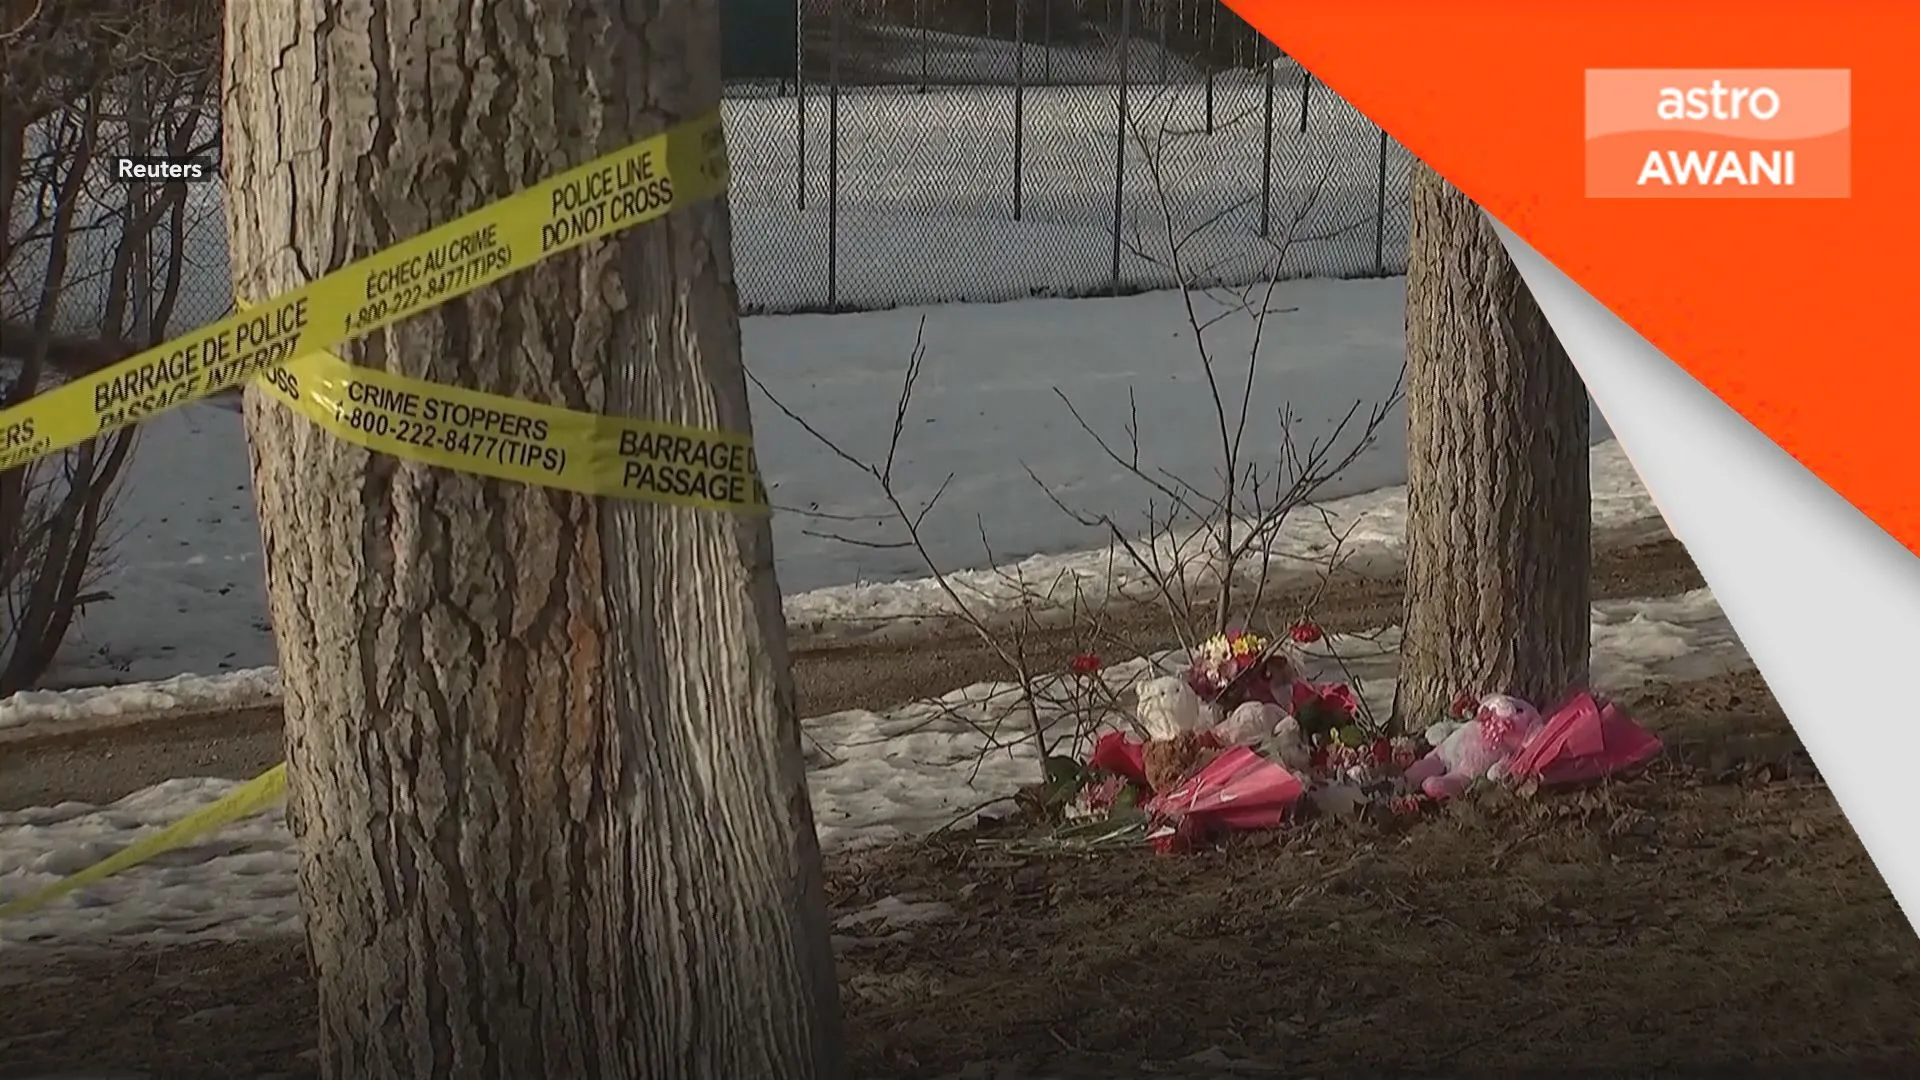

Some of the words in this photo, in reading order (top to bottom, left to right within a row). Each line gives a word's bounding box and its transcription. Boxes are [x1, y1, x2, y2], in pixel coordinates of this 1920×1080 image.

[552, 166, 613, 217] POLICE
[616, 151, 653, 191] LINE
[542, 218, 570, 252] DO
[571, 201, 606, 240] NOT
[611, 177, 673, 223] CROSS
[424, 244, 447, 276] AU
[449, 223, 498, 263] CRIME
[95, 342, 199, 414] BARRAGE
[203, 330, 230, 367] DE
[236, 296, 308, 353] POLICE
[348, 381, 420, 417] CRIME
[422, 398, 549, 441] STOPPERS
[618, 429, 744, 472] BARRAGE
[623, 461, 746, 503] PASSAGE
